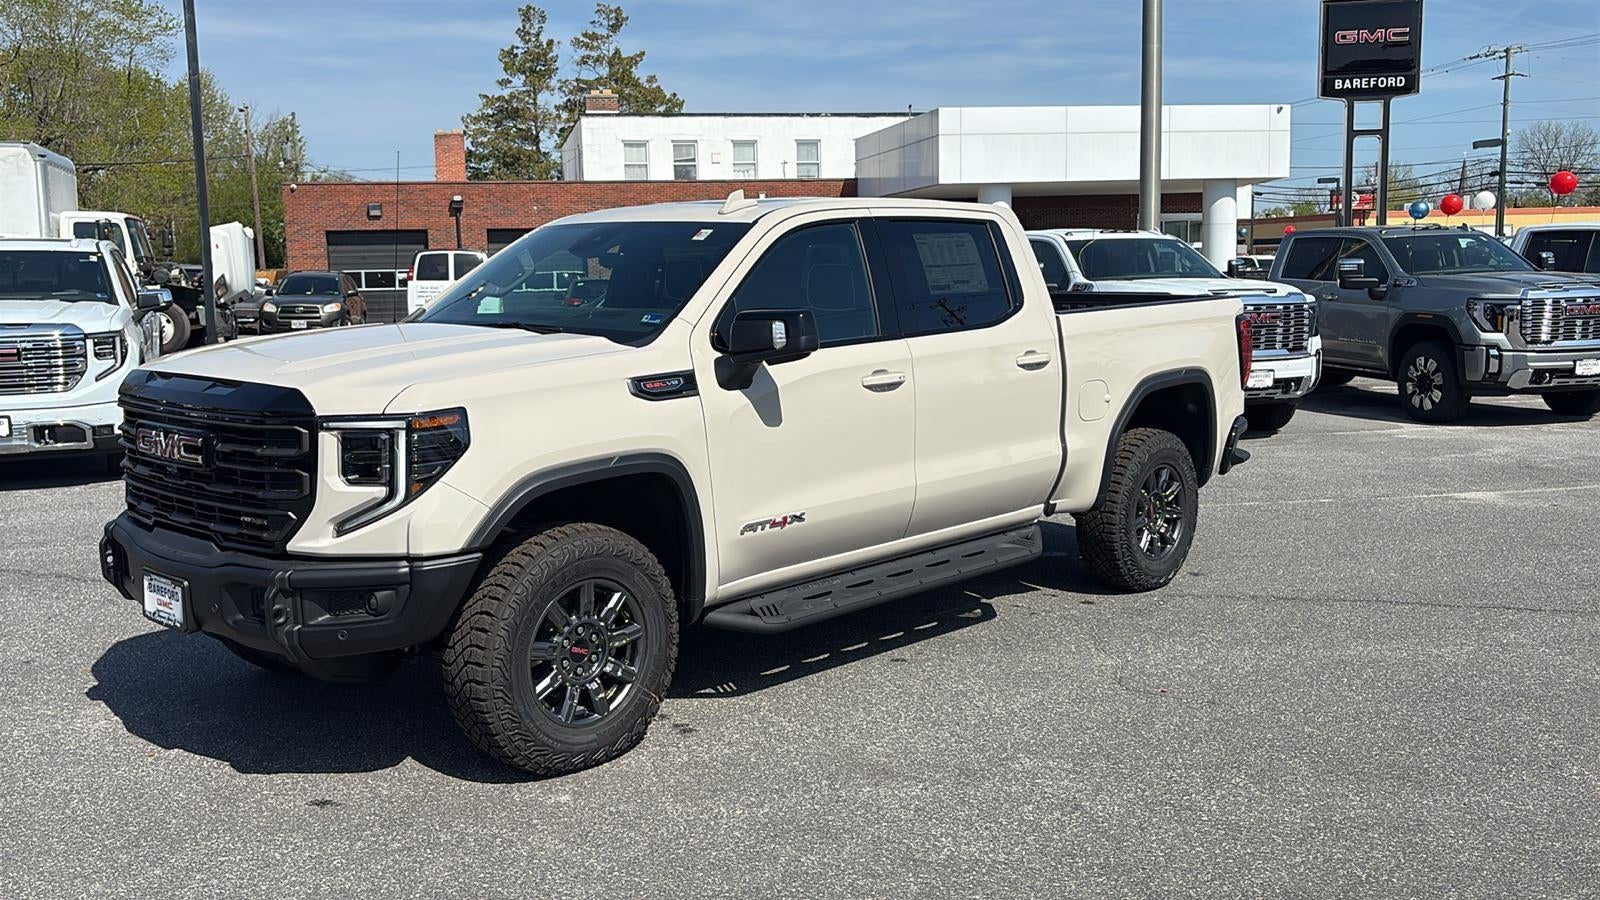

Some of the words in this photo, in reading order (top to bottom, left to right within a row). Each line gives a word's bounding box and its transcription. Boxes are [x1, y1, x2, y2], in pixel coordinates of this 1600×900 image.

[1335, 27, 1409, 44] GMC
[1334, 76, 1406, 89] BAREFORD
[1567, 304, 1600, 316] GM
[1250, 312, 1281, 324] MC
[136, 427, 203, 465] GMC
[739, 511, 806, 536] AT4X
[147, 581, 180, 602] BAREFORD
[156, 598, 173, 610] GMC
[571, 646, 589, 655] GMC
